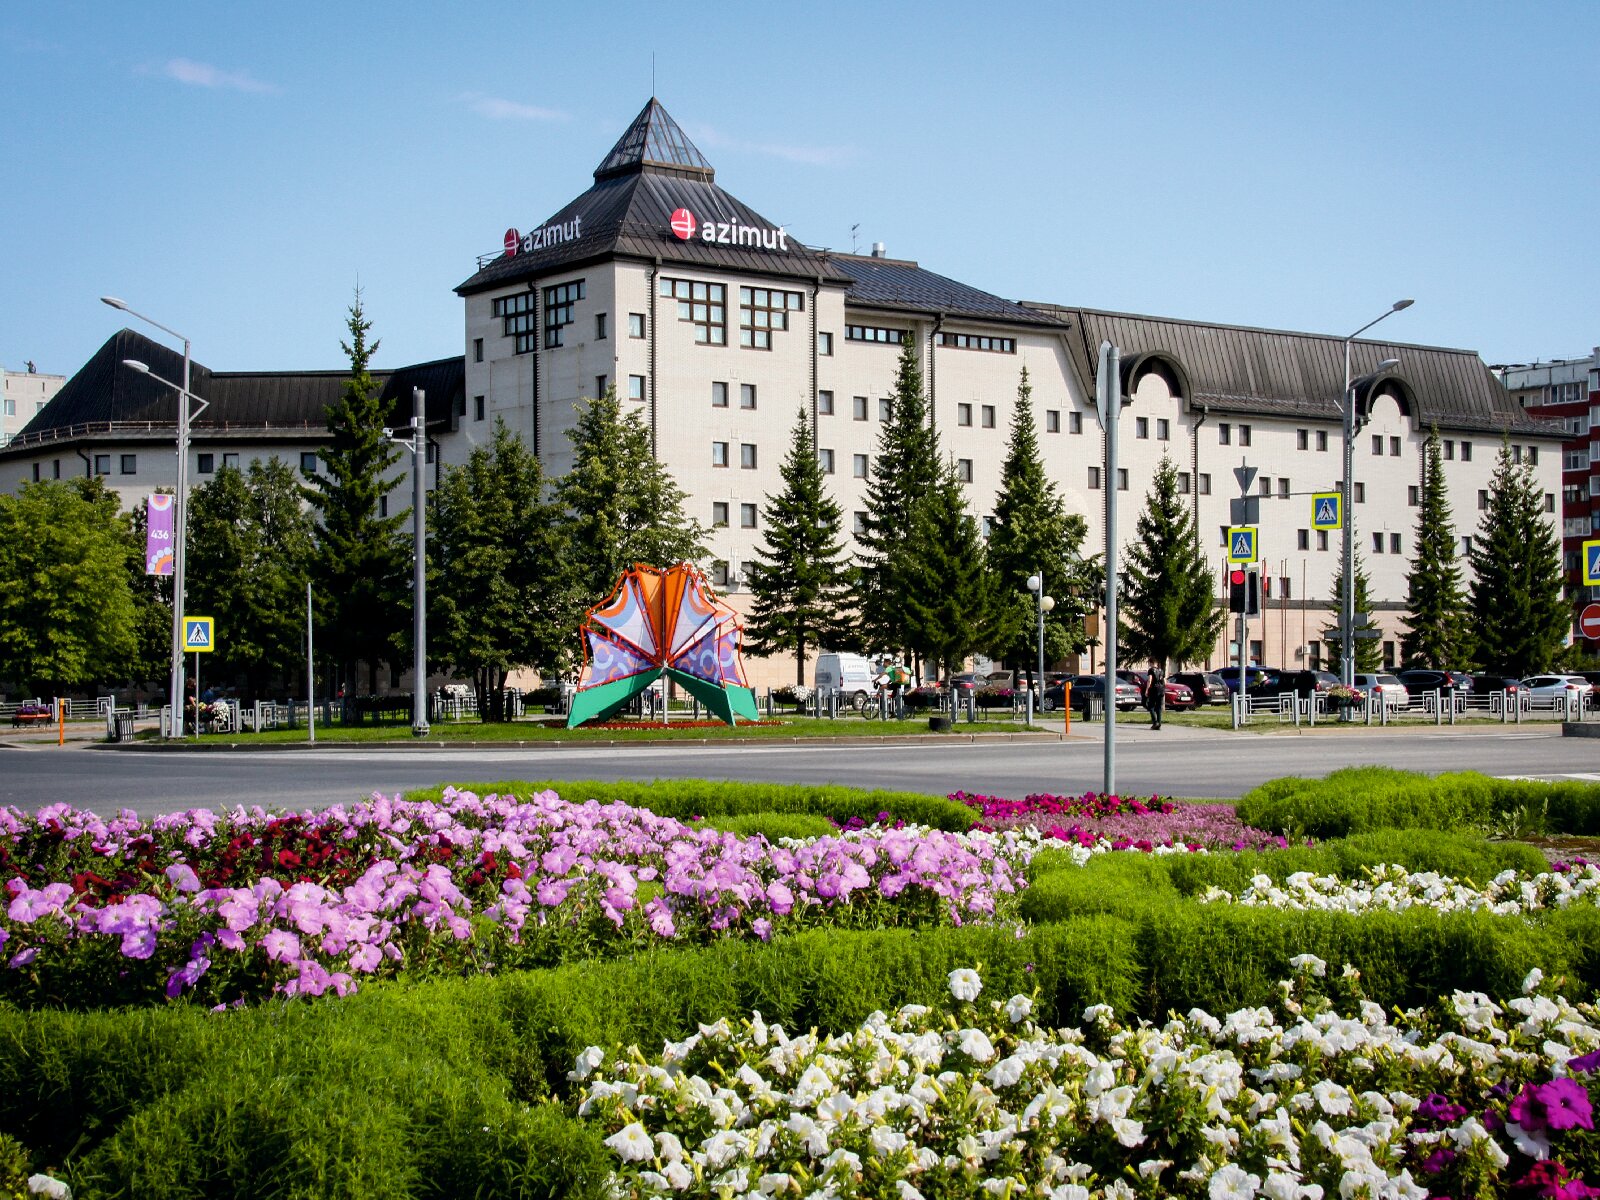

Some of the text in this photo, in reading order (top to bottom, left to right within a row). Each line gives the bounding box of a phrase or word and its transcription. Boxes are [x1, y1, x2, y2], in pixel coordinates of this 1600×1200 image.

[523, 215, 582, 252] azimut
[701, 217, 788, 251] azimut
[150, 529, 169, 540] 436
